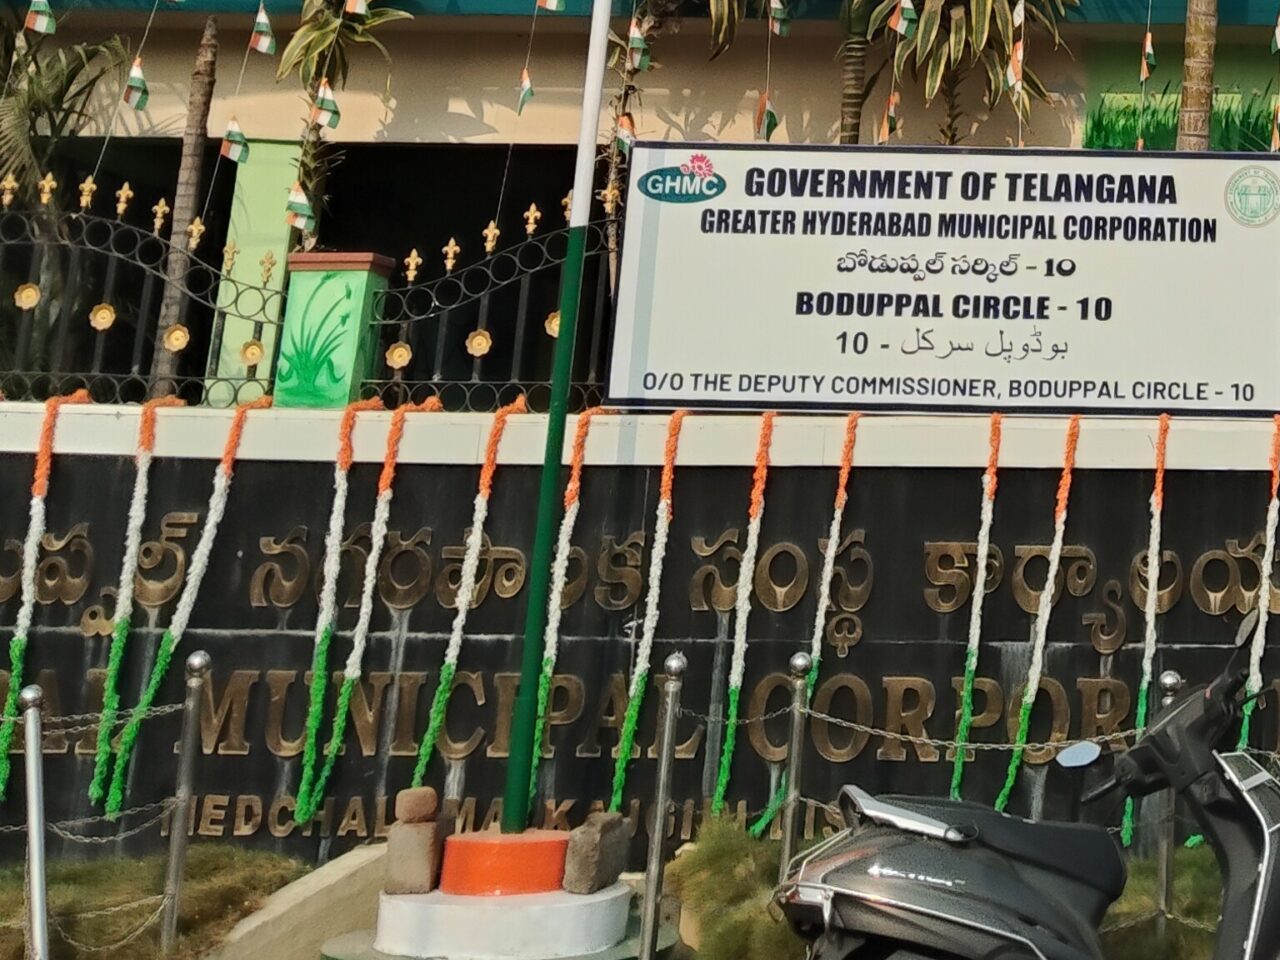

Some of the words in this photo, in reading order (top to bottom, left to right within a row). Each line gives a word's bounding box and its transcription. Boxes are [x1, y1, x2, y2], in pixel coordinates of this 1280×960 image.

[646, 174, 719, 197] GHMC
[744, 167, 953, 200] GOVERNMENT
[960, 171, 998, 201] OF
[1004, 172, 1177, 205] TELANGANA
[700, 208, 796, 235] GREATER
[801, 210, 932, 238] HYDERABAD
[937, 213, 1057, 240] MUNICIPAL
[1063, 215, 1217, 243] CORPORATION
[836, 249, 947, 282] బోడుప్పల్
[1044, 258, 1077, 277] 10
[795, 292, 944, 318] BODUPPAL
[951, 294, 1050, 320] CIRCLE
[1076, 297, 1113, 321] 10
[836, 331, 869, 355] 10
[690, 373, 732, 392] THE
[738, 374, 826, 394] DEPUTY
[830, 375, 1002, 400] COMMISSIONER,
[1008, 379, 1126, 400] BODUPPAL
[1132, 381, 1209, 401] CIRCLE
[1230, 383, 1255, 402] 10
